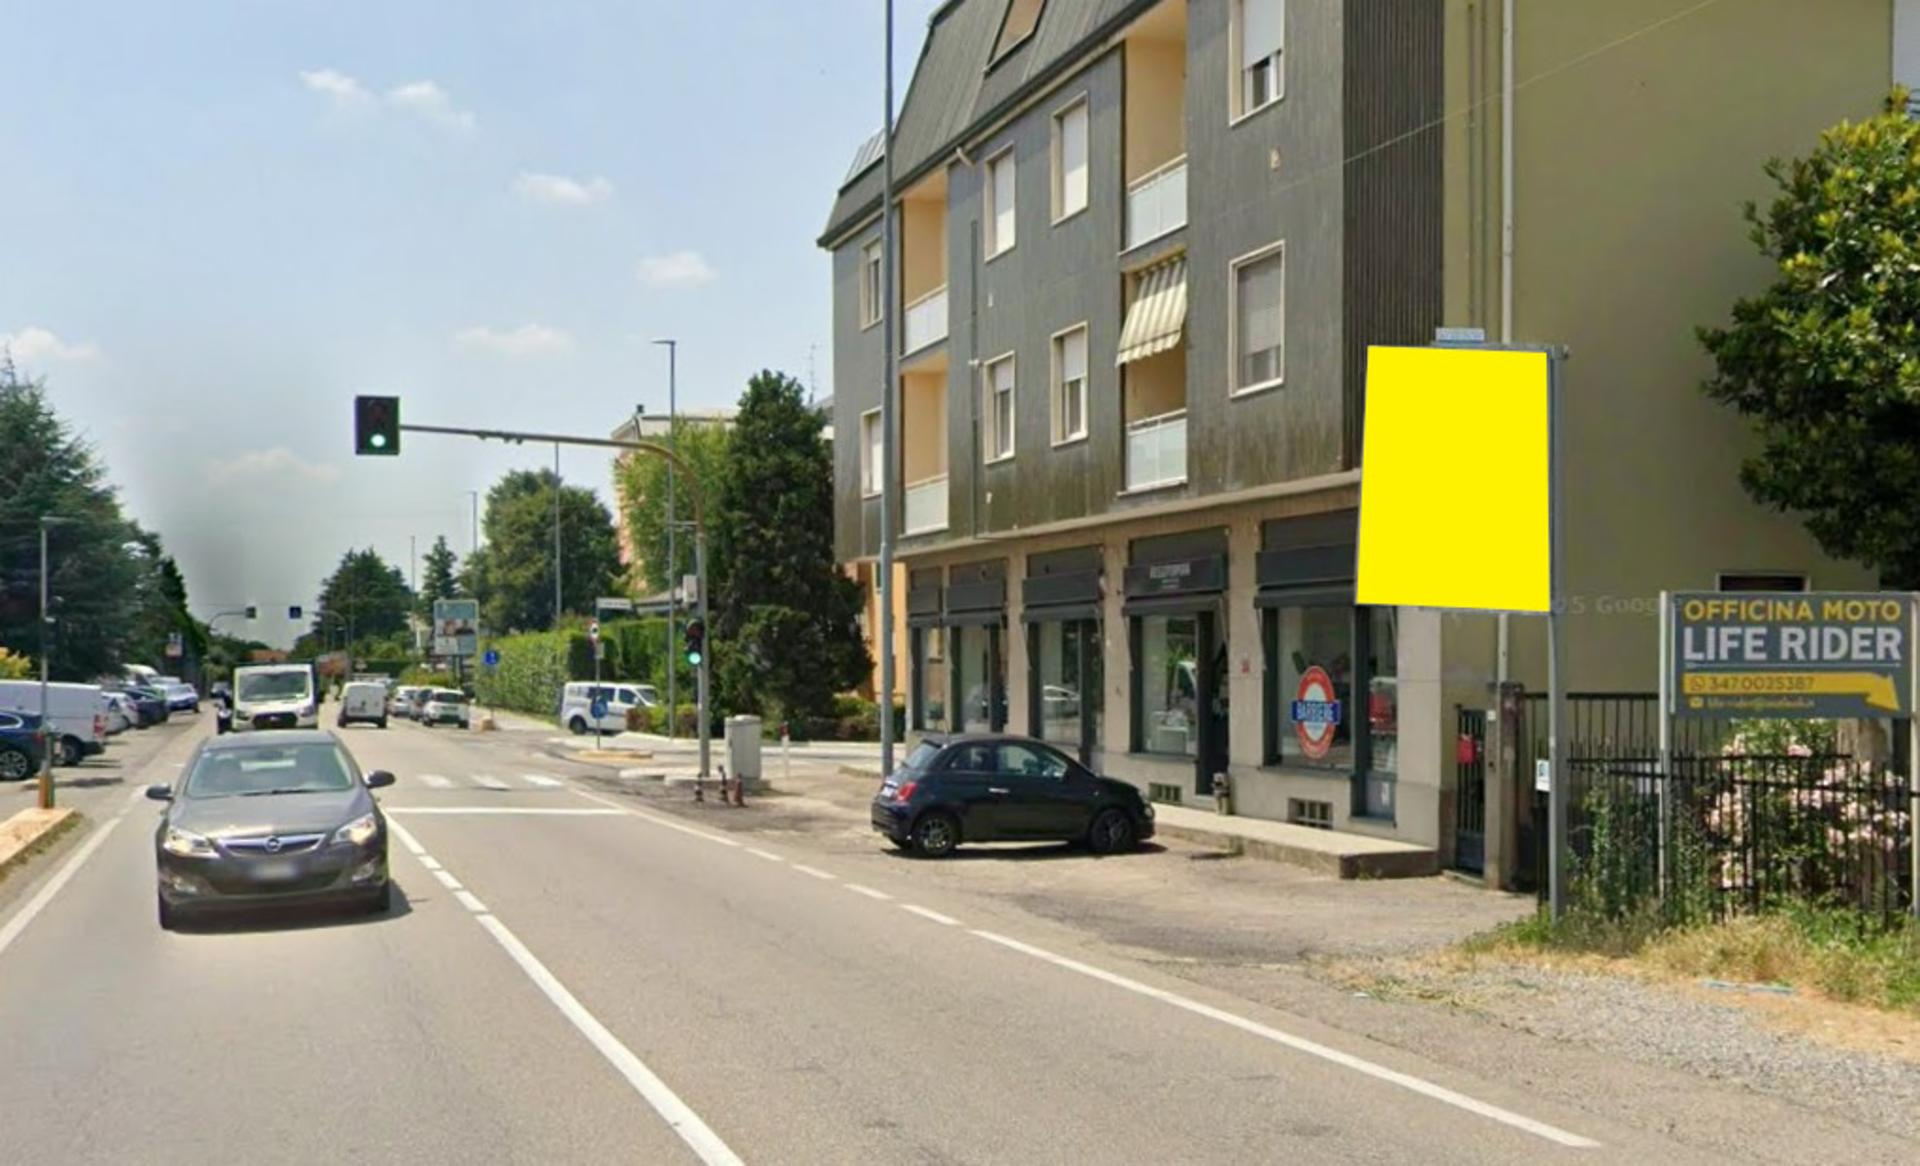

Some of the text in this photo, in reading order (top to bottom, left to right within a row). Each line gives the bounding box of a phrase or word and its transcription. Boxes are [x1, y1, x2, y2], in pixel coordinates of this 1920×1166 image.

[1684, 600, 1901, 622] OFFICINA MOTO
[1682, 626, 1903, 661] LIFE RIDER
